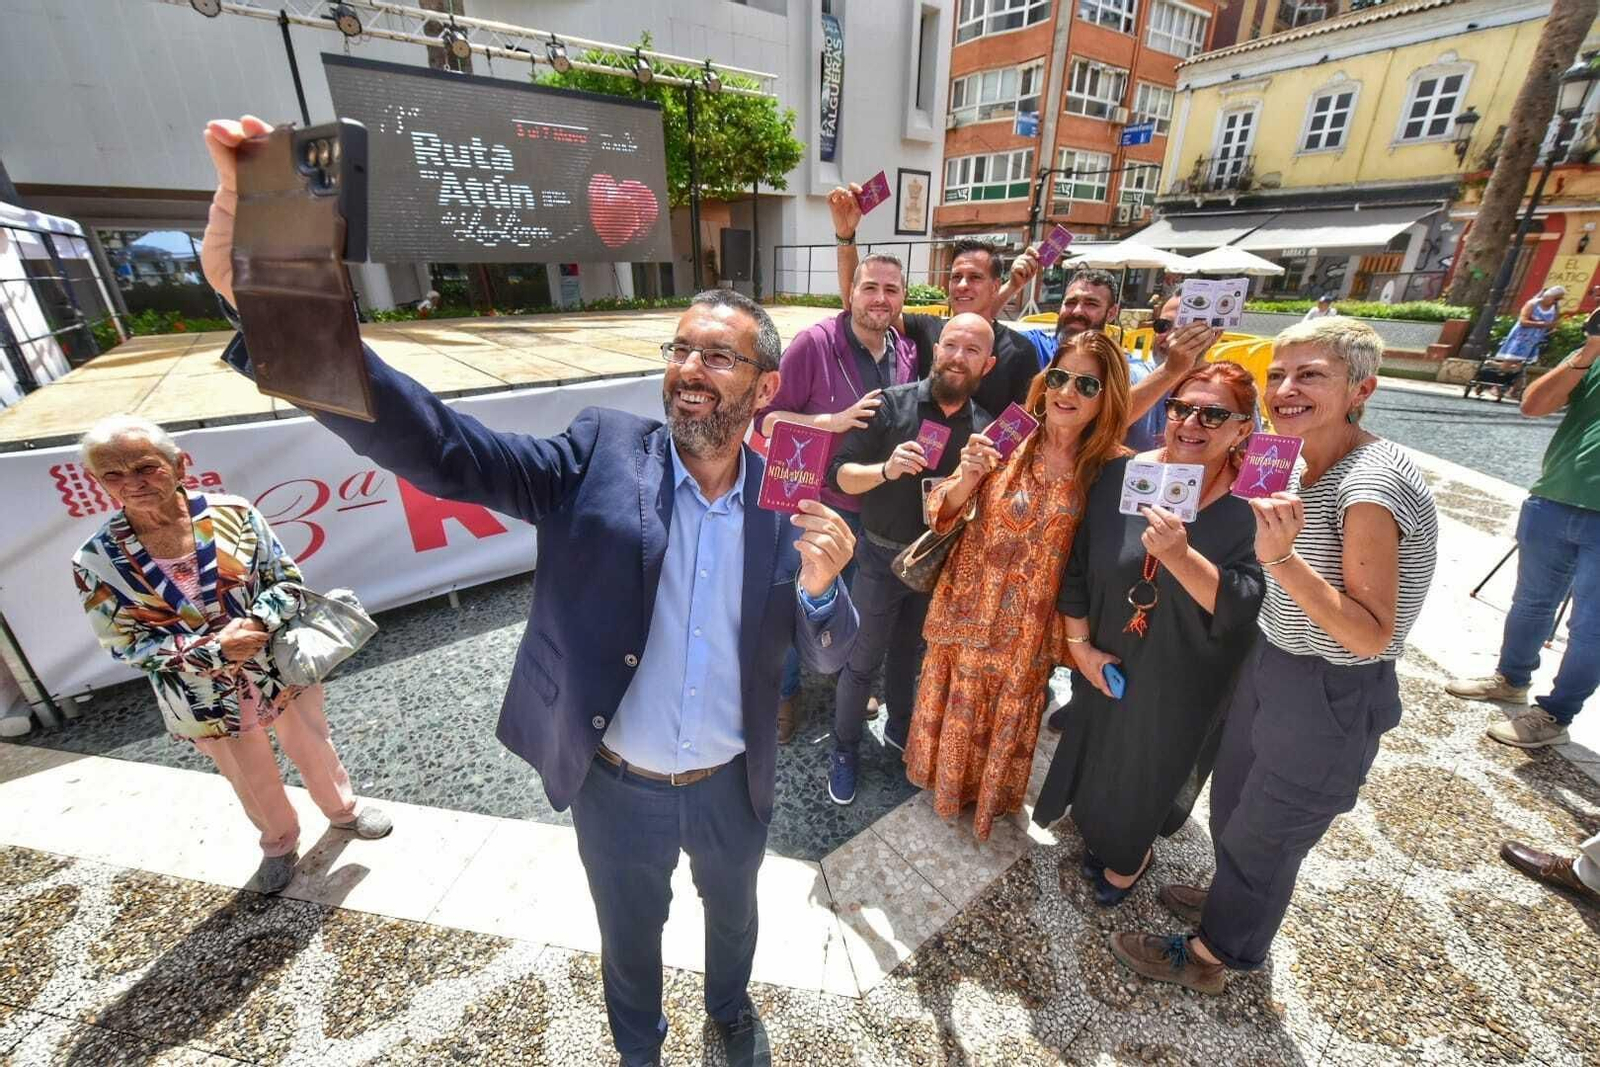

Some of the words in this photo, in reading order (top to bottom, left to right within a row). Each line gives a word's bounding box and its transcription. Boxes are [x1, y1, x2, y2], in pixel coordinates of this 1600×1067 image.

[824, 35, 833, 87] NACHO
[826, 38, 842, 138] FALGUERAS
[411, 131, 514, 171] Ruta
[438, 171, 535, 210] Atún
[1549, 270, 1588, 282] PATIO
